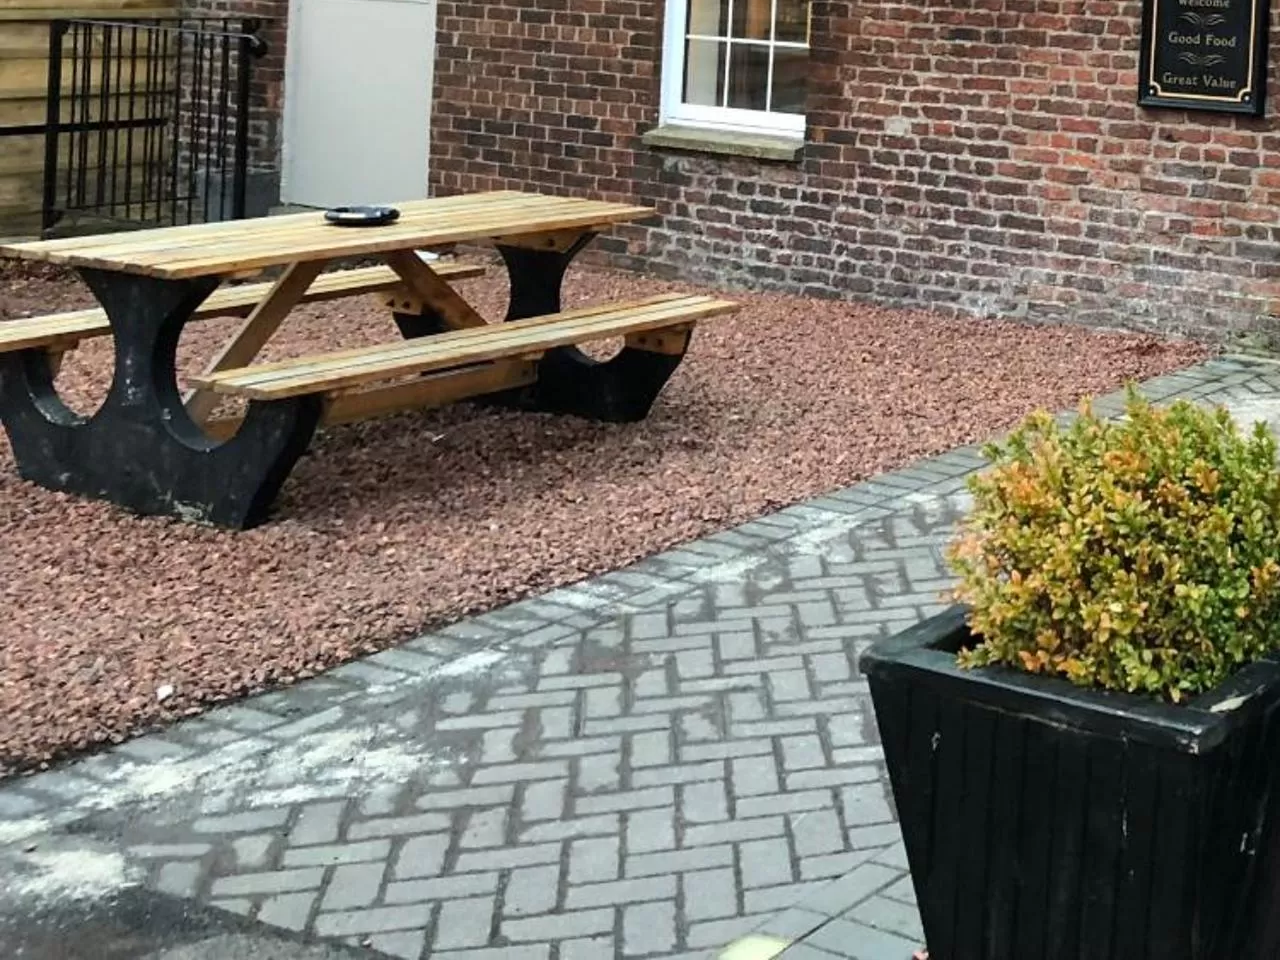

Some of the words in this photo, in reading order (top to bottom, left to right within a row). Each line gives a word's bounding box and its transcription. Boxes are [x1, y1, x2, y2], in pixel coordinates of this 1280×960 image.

[1168, 31, 1201, 45] Good
[1205, 34, 1236, 47] Food
[1163, 72, 1199, 86] Great
[1203, 75, 1236, 89] Value
